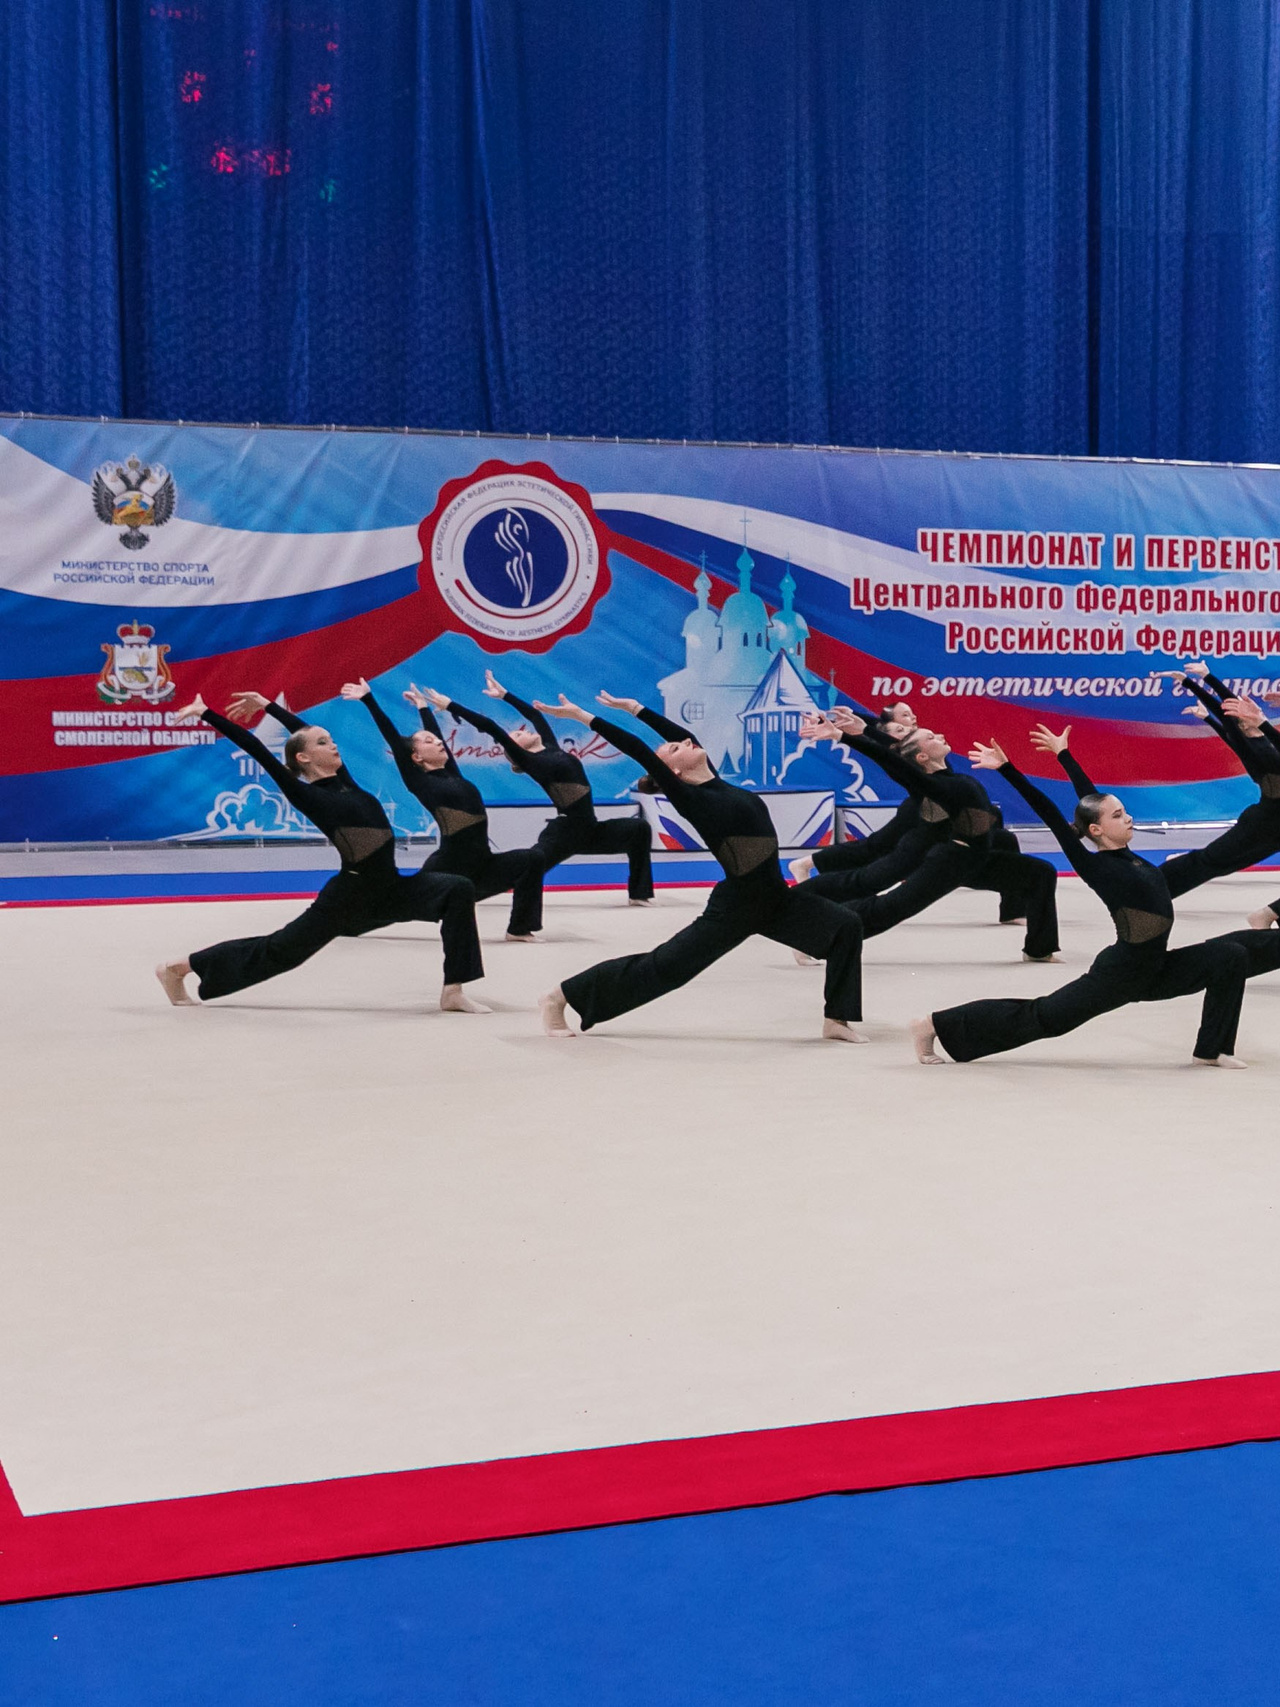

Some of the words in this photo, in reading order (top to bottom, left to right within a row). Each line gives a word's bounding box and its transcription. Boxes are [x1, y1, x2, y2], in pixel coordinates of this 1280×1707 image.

[919, 530, 1104, 568] ЧЕМПИОНАТ
[1114, 535, 1134, 568] И
[61, 560, 160, 572] МИНИСТЕРСТВО
[163, 562, 210, 573] СПОРТА
[53, 571, 136, 584] РОССИЙСКОЙ
[138, 574, 215, 586] ФЕДЕРАЦИИ
[852, 577, 1065, 612] Центрального
[947, 620, 1125, 652] Российской
[871, 675, 913, 697] по
[920, 672, 1163, 698] эстетической
[52, 711, 162, 727] МИНИСТЕРСТВО
[54, 728, 150, 746] СМОЛЕНСКОЙ
[152, 730, 216, 746] ОБЛАСТИ
